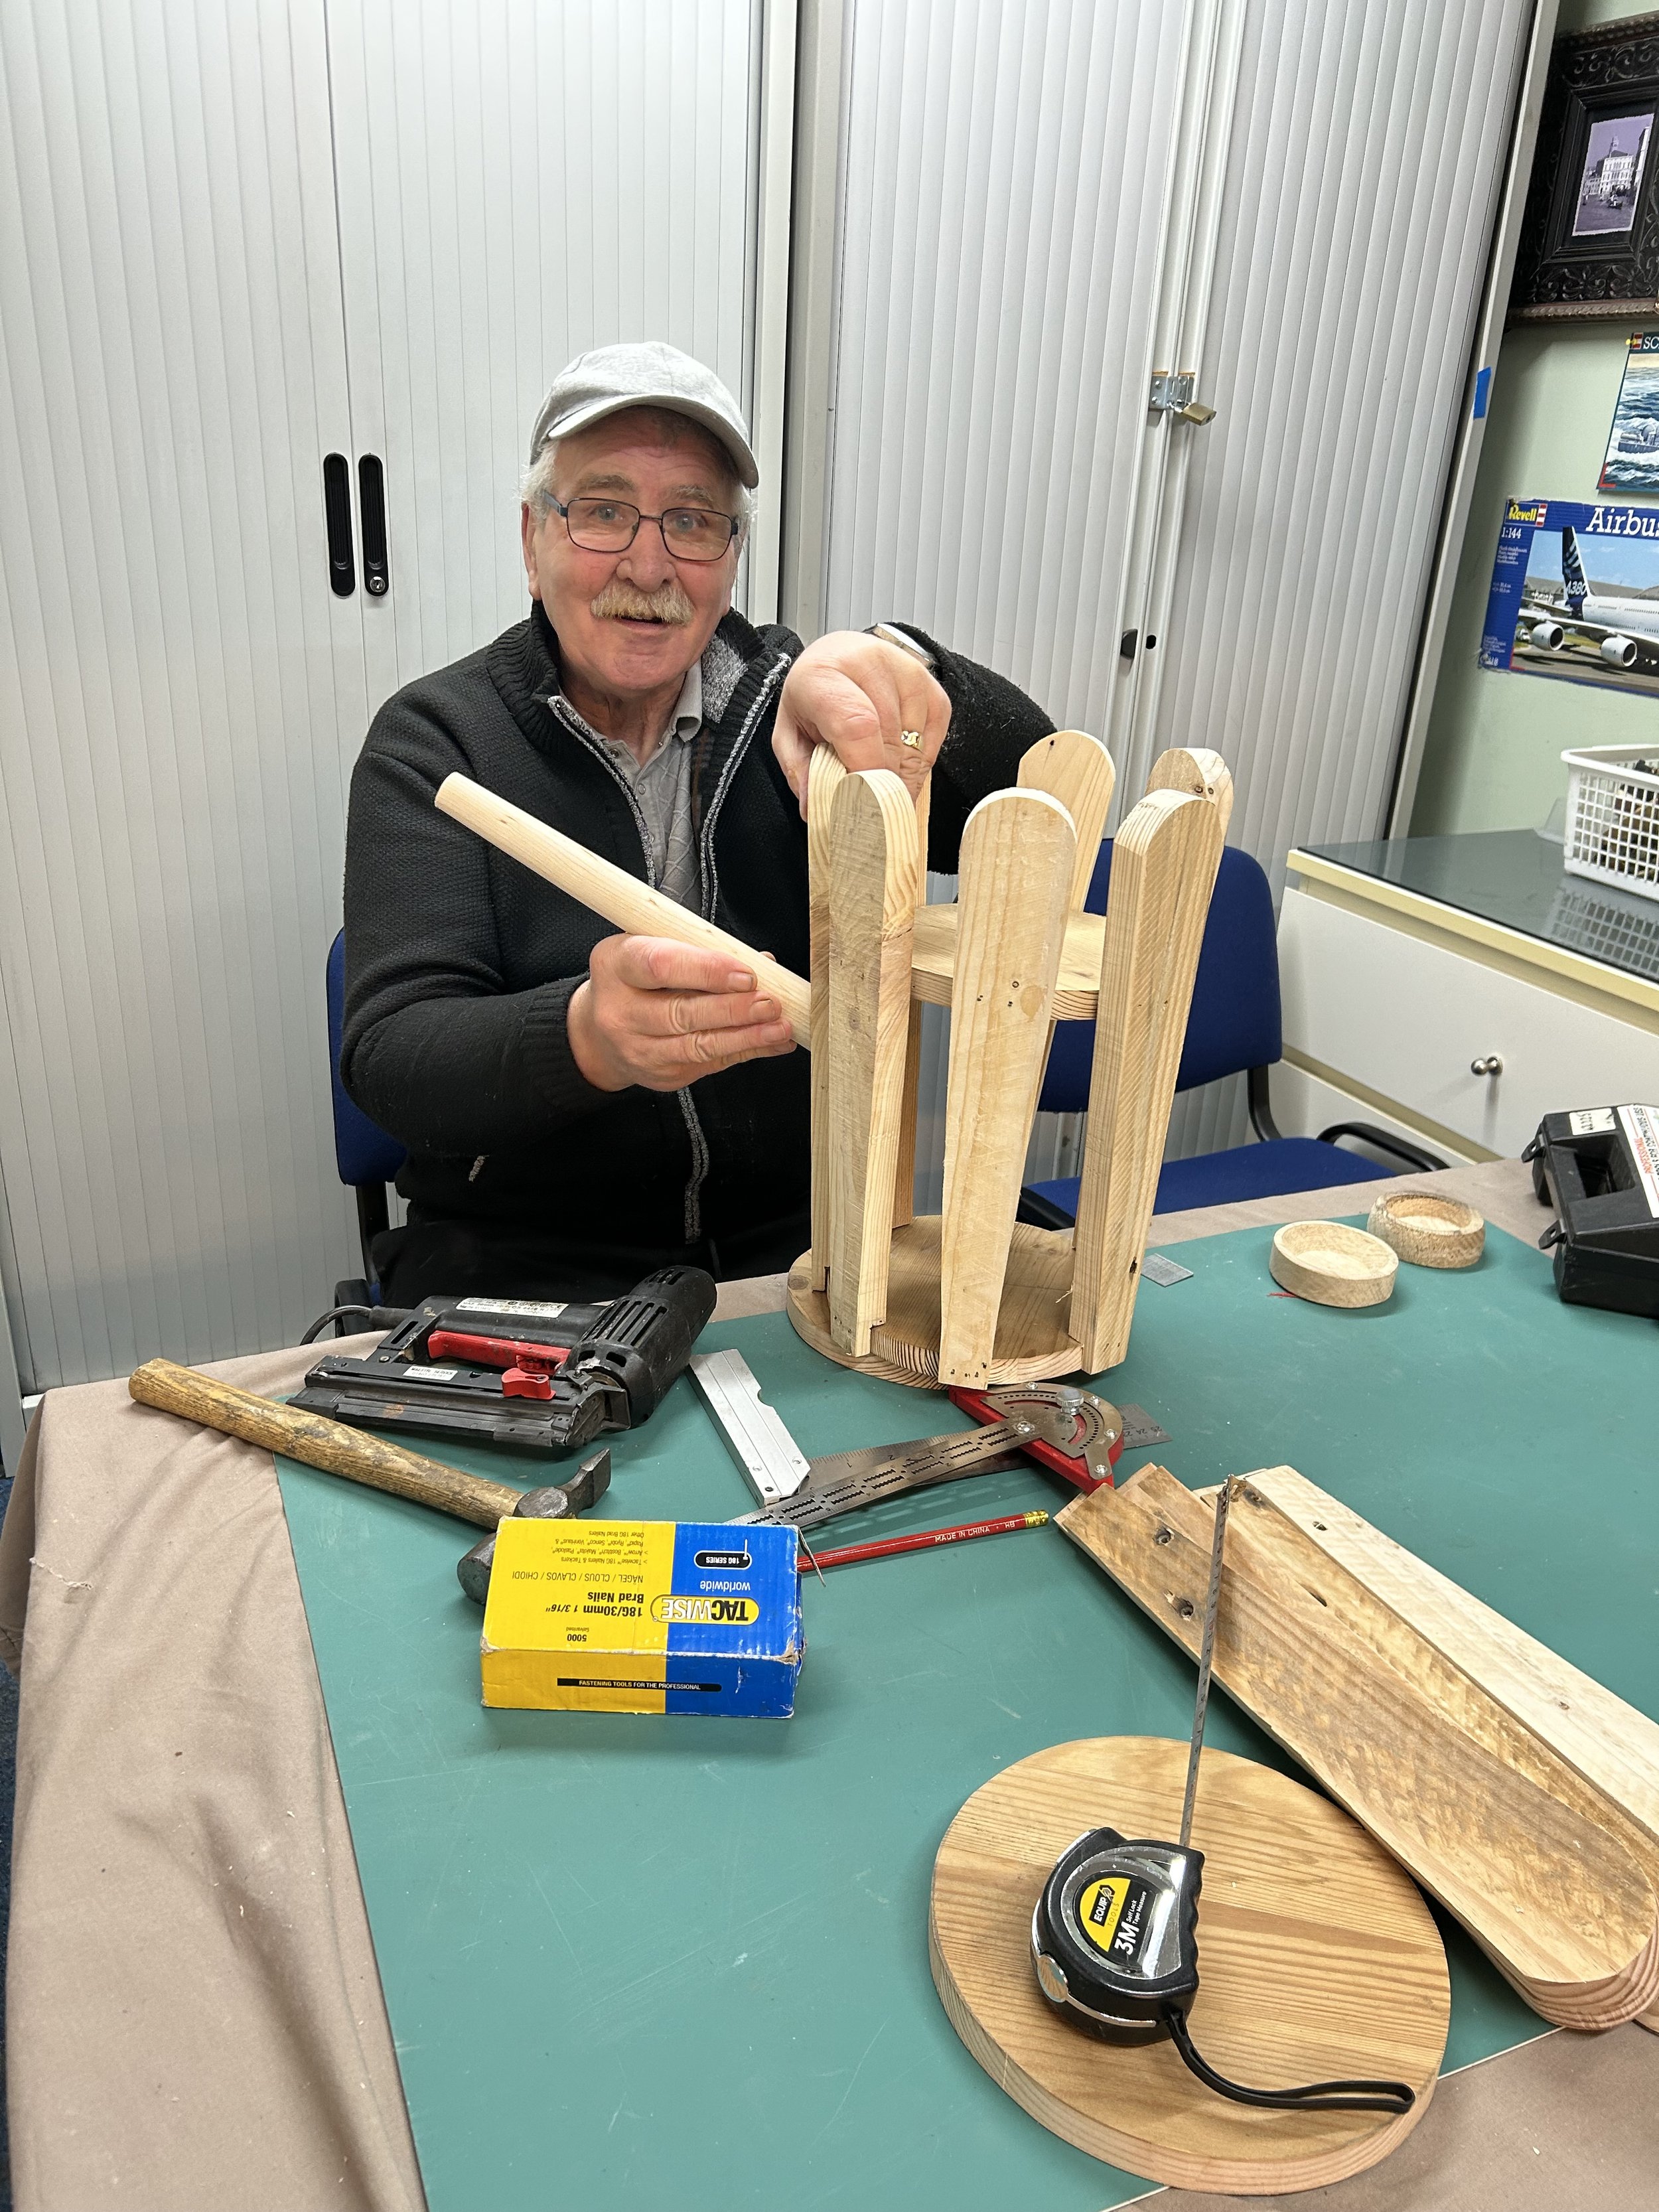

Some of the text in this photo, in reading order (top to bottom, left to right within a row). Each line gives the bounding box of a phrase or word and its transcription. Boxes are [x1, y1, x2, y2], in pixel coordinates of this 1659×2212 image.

[1643, 336, 1659, 350] SC
[1508, 504, 1538, 521] Revell
[1585, 507, 1659, 537] Airbu
[1501, 527, 1522, 539] 1:144
[1566, 580, 1587, 595] A380
[968, 1526, 990, 1536] CHINA
[512, 1571, 539, 1580] CHIODI
[547, 1572, 577, 1581] CLAVOS
[585, 1573, 610, 1582] CLOUS
[618, 1574, 643, 1585] NÄGEL
[700, 1580, 751, 1593] worldwide
[587, 1591, 644, 1603] Brad Nails
[583, 1605, 642, 1617] 18G/30mm
[1094, 1897, 1108, 1922] EQUIP
[1132, 1891, 1147, 1925] Tape Measure
[1108, 1903, 1119, 1927] TOOLS
[1114, 1921, 1139, 1955] 3M
